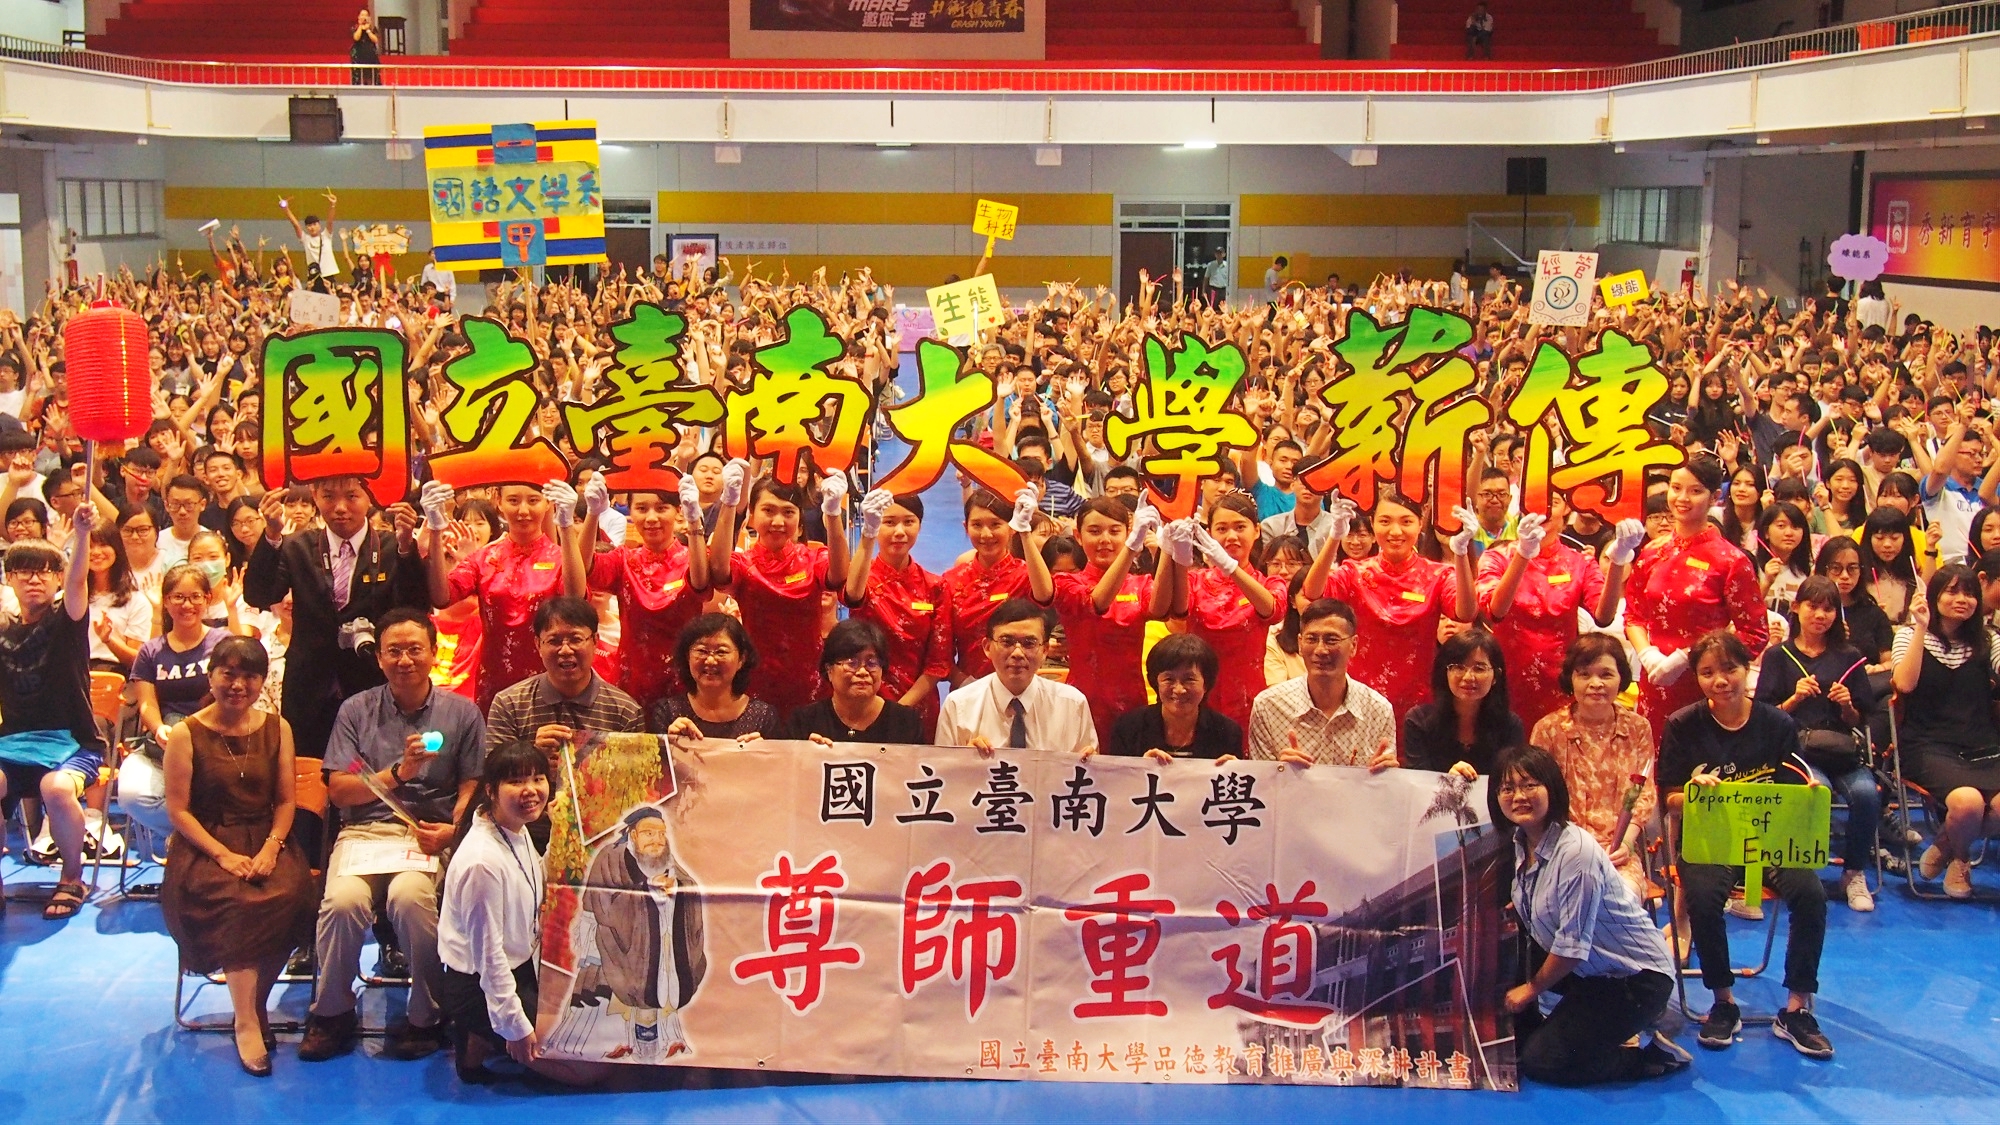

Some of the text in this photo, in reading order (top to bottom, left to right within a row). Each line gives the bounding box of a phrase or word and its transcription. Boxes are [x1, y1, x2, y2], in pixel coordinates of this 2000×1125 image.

[862, 12, 926, 28] 邀您一起
[978, 203, 1014, 224] 生物
[984, 220, 1015, 239] 科技
[1541, 254, 1594, 279] 經管
[936, 286, 993, 324] 生態
[156, 658, 211, 680] LAZY
[820, 761, 1267, 846] 國立臺南大學
[1688, 782, 1782, 812] Department
[1751, 811, 1771, 833] of
[1743, 836, 1826, 866] English
[735, 855, 1335, 1025] 尊師重道
[980, 1038, 1472, 1086] 國立臺南大學品德教育推廣與深耕計畫
